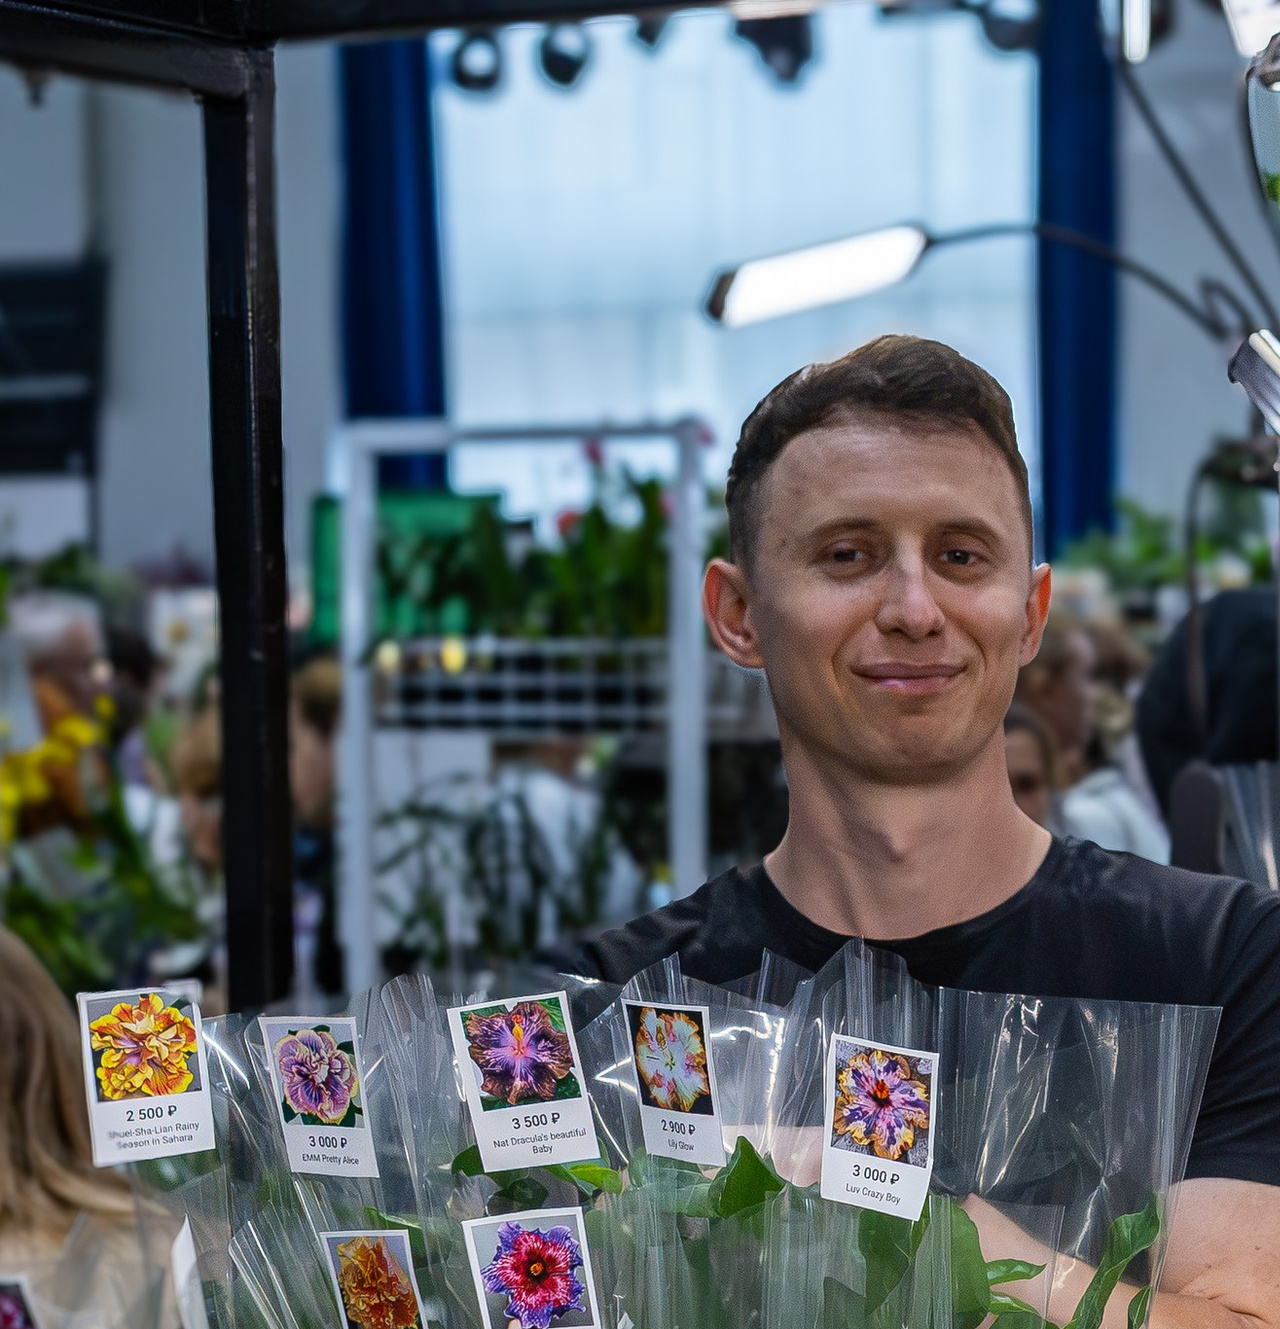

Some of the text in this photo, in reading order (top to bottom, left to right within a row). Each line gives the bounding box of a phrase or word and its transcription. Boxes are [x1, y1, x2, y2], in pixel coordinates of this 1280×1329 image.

[126, 1110, 135, 1122] 2
[138, 1106, 164, 1120] 500
[175, 1121, 200, 1132] Rainy
[512, 1118, 521, 1130] 3
[524, 1113, 548, 1128] 500
[660, 1119, 667, 1131] 2
[668, 1122, 686, 1134] 900
[152, 1136, 160, 1146] in
[162, 1133, 194, 1144] Sahara
[308, 1135, 316, 1147] 3
[318, 1136, 338, 1148] 000
[493, 1128, 587, 1149] Nat Dracula's beautiful
[679, 1140, 694, 1150] Glow
[532, 1144, 553, 1155] Baby
[302, 1153, 359, 1165] EMM Pretty Alice
[852, 1164, 861, 1176] 3
[863, 1166, 887, 1183] 000
[846, 1183, 902, 1205] Luv Crazy Boy
